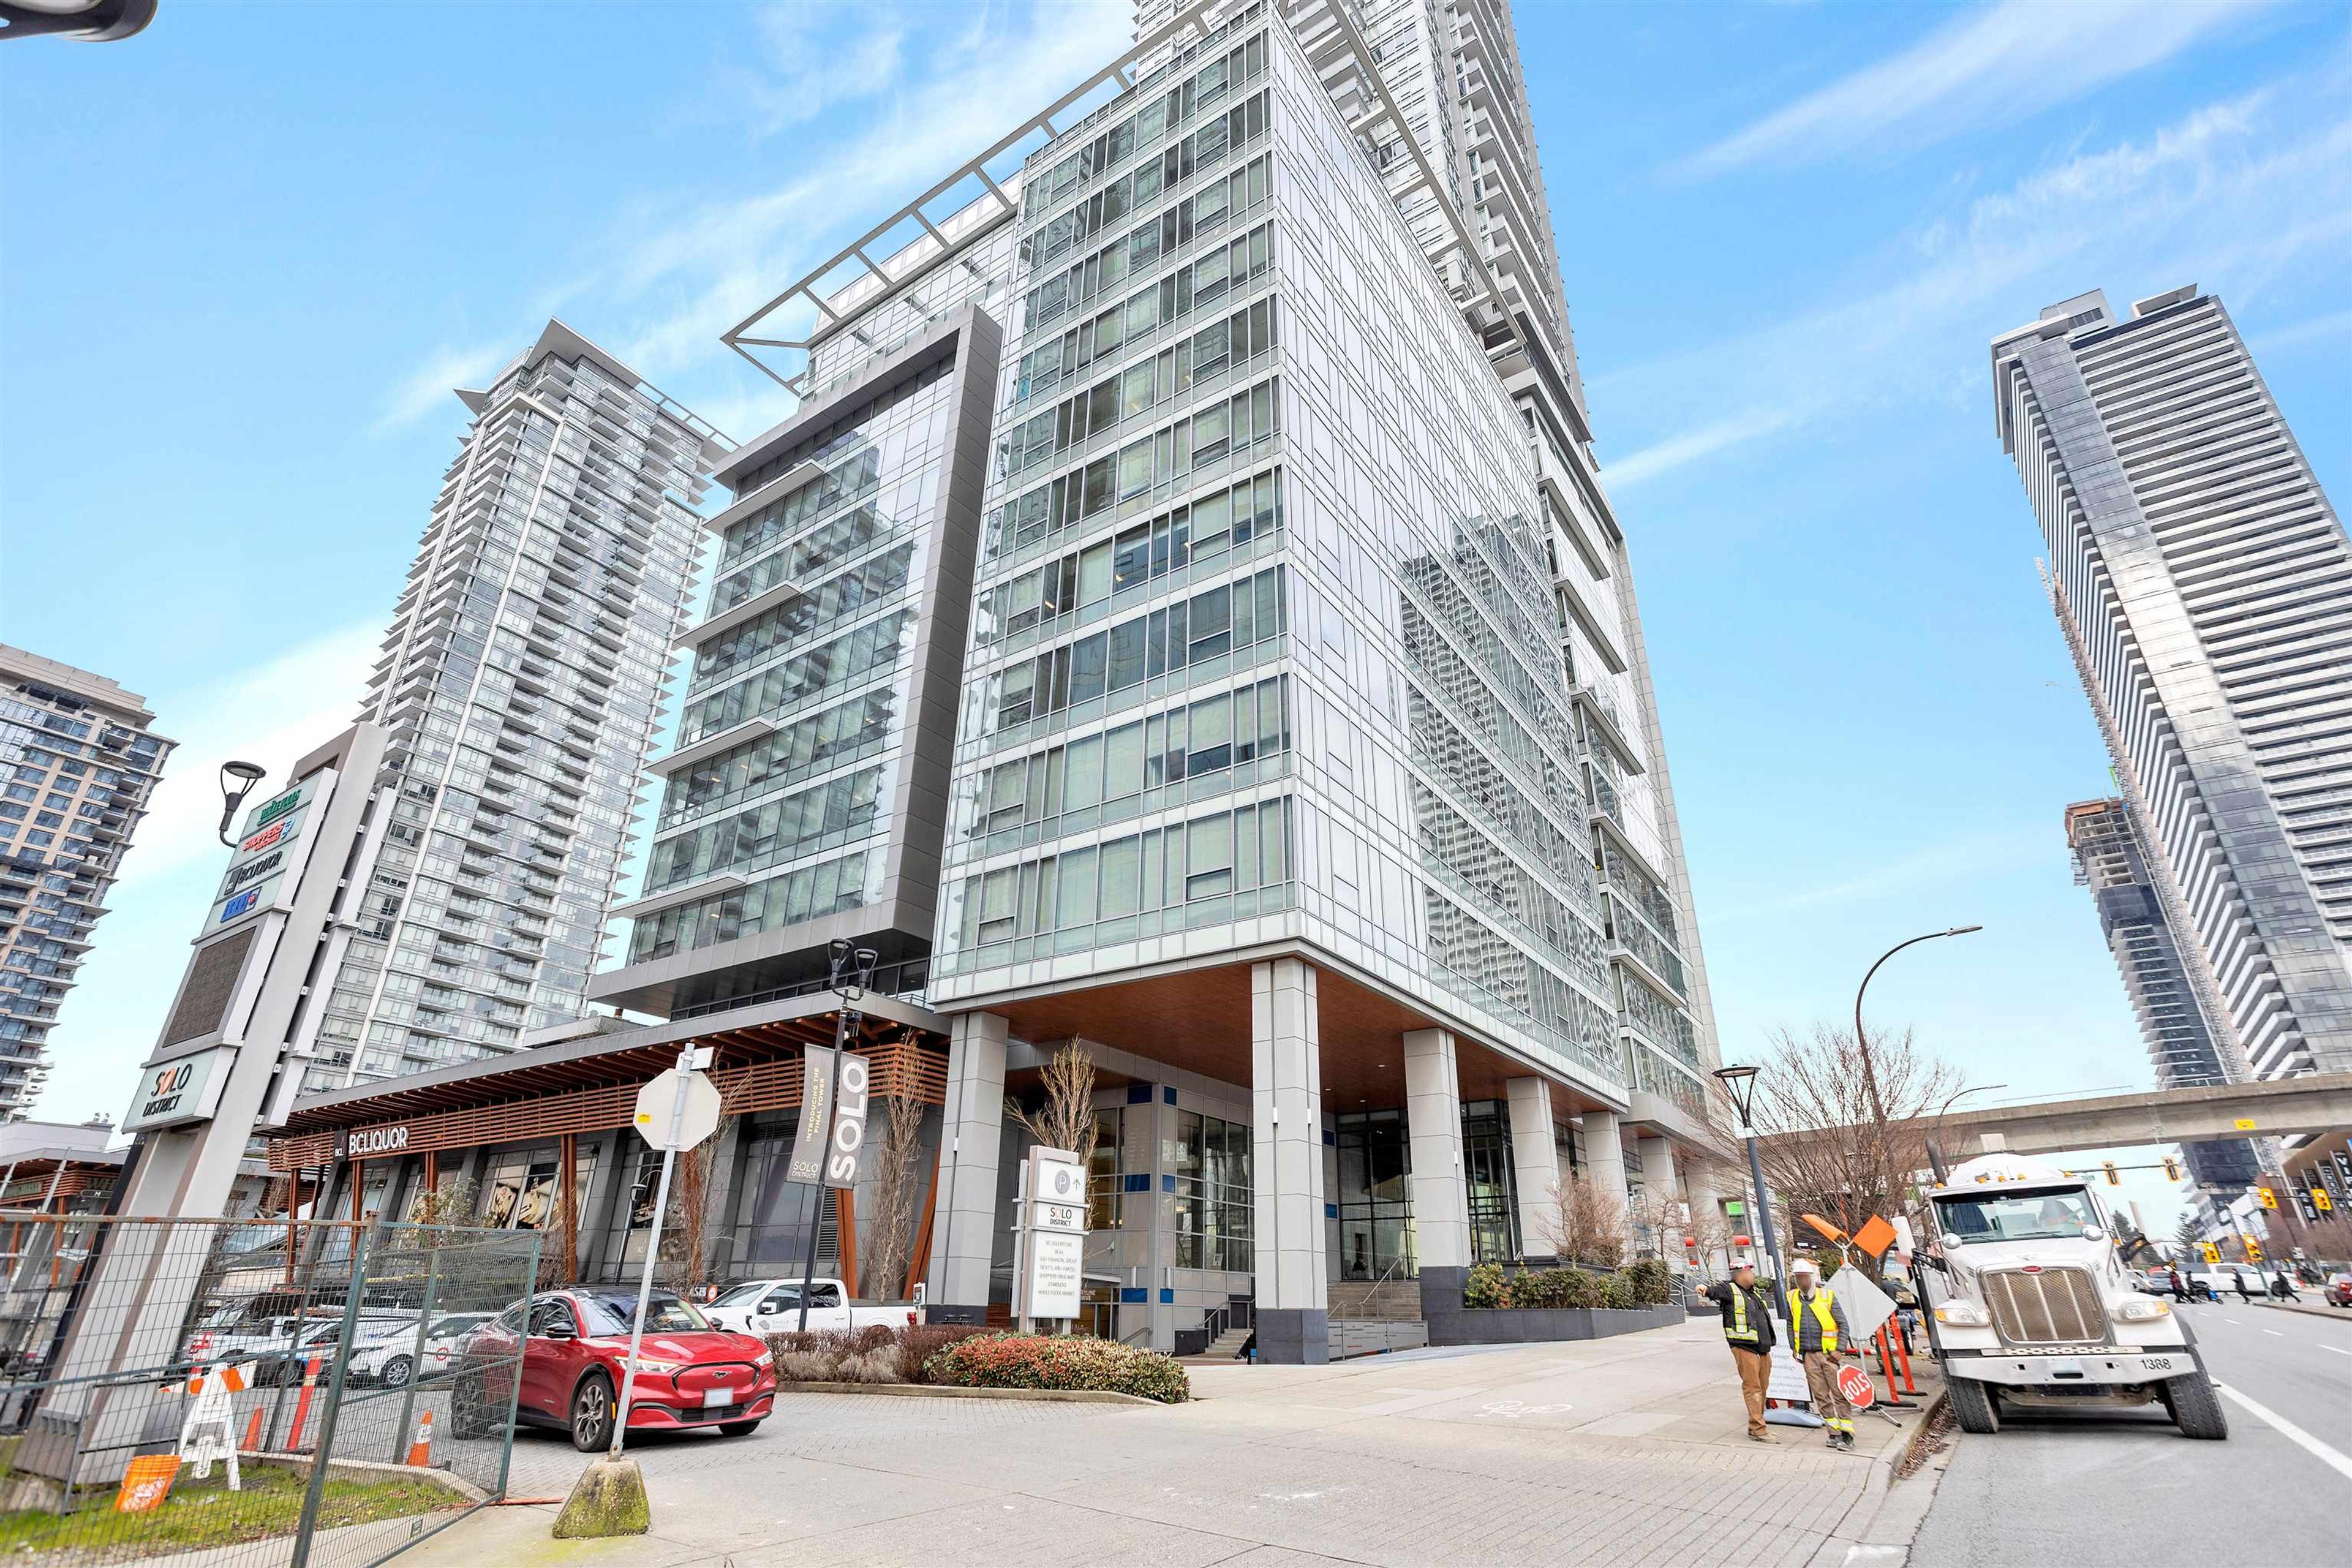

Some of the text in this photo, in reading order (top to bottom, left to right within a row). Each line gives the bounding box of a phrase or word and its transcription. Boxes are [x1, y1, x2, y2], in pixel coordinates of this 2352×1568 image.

[151, 1063, 192, 1097] SOLO
[142, 1094, 183, 1117] DISTRICT
[806, 1085, 818, 1141] INTRODUCING
[814, 1108, 823, 1133] FINAL
[830, 1061, 867, 1182] SOLO
[349, 1126, 408, 1154] BCLIQUOR
[791, 1170, 816, 1179] DISTRICT
[793, 1161, 818, 1173] SOLO
[1049, 1218, 1071, 1227] DISTRICT
[1050, 1207, 1072, 1219] SOLO
[1843, 1373, 1871, 1401] STOP
